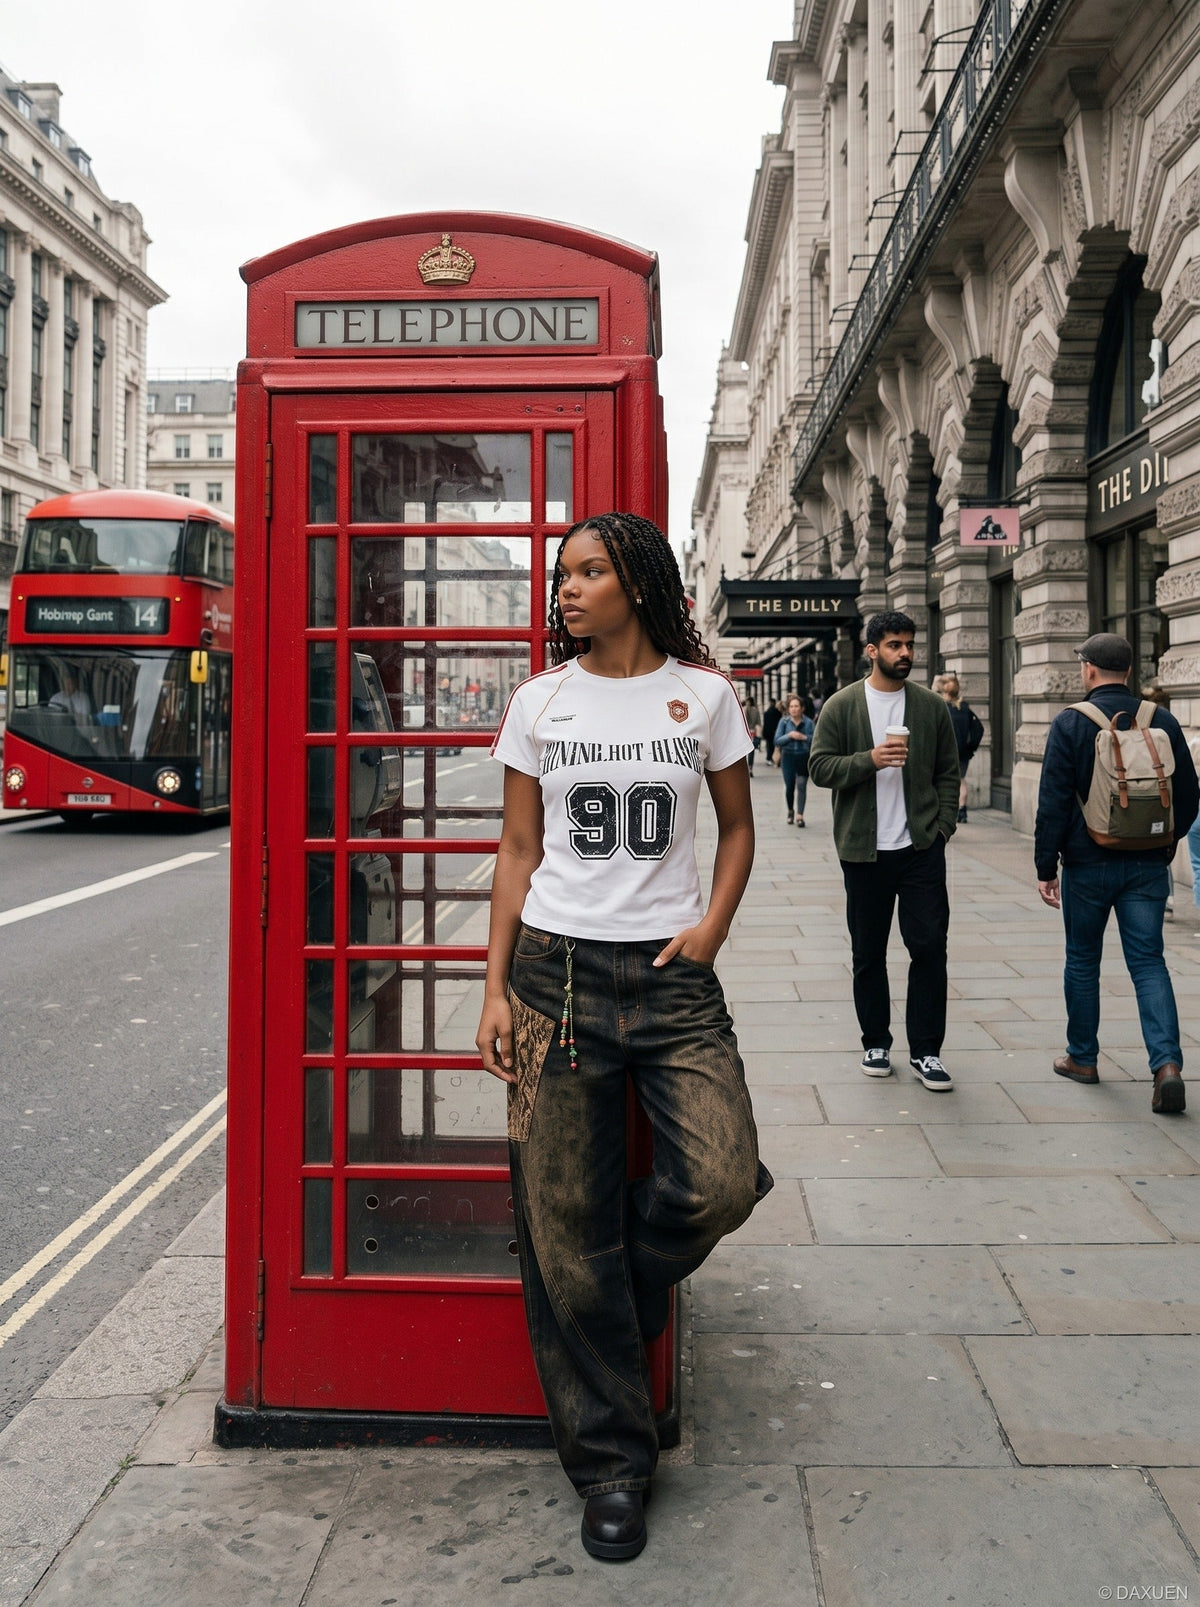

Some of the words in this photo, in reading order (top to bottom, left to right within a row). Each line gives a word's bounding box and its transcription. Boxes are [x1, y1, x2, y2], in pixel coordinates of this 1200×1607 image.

[307, 306, 588, 344] TELEPHONE
[1098, 466, 1132, 513] THE
[135, 605, 158, 627] 14
[746, 599, 782, 612] THE
[790, 599, 841, 612] DILLY
[565, 781, 678, 861] 90
